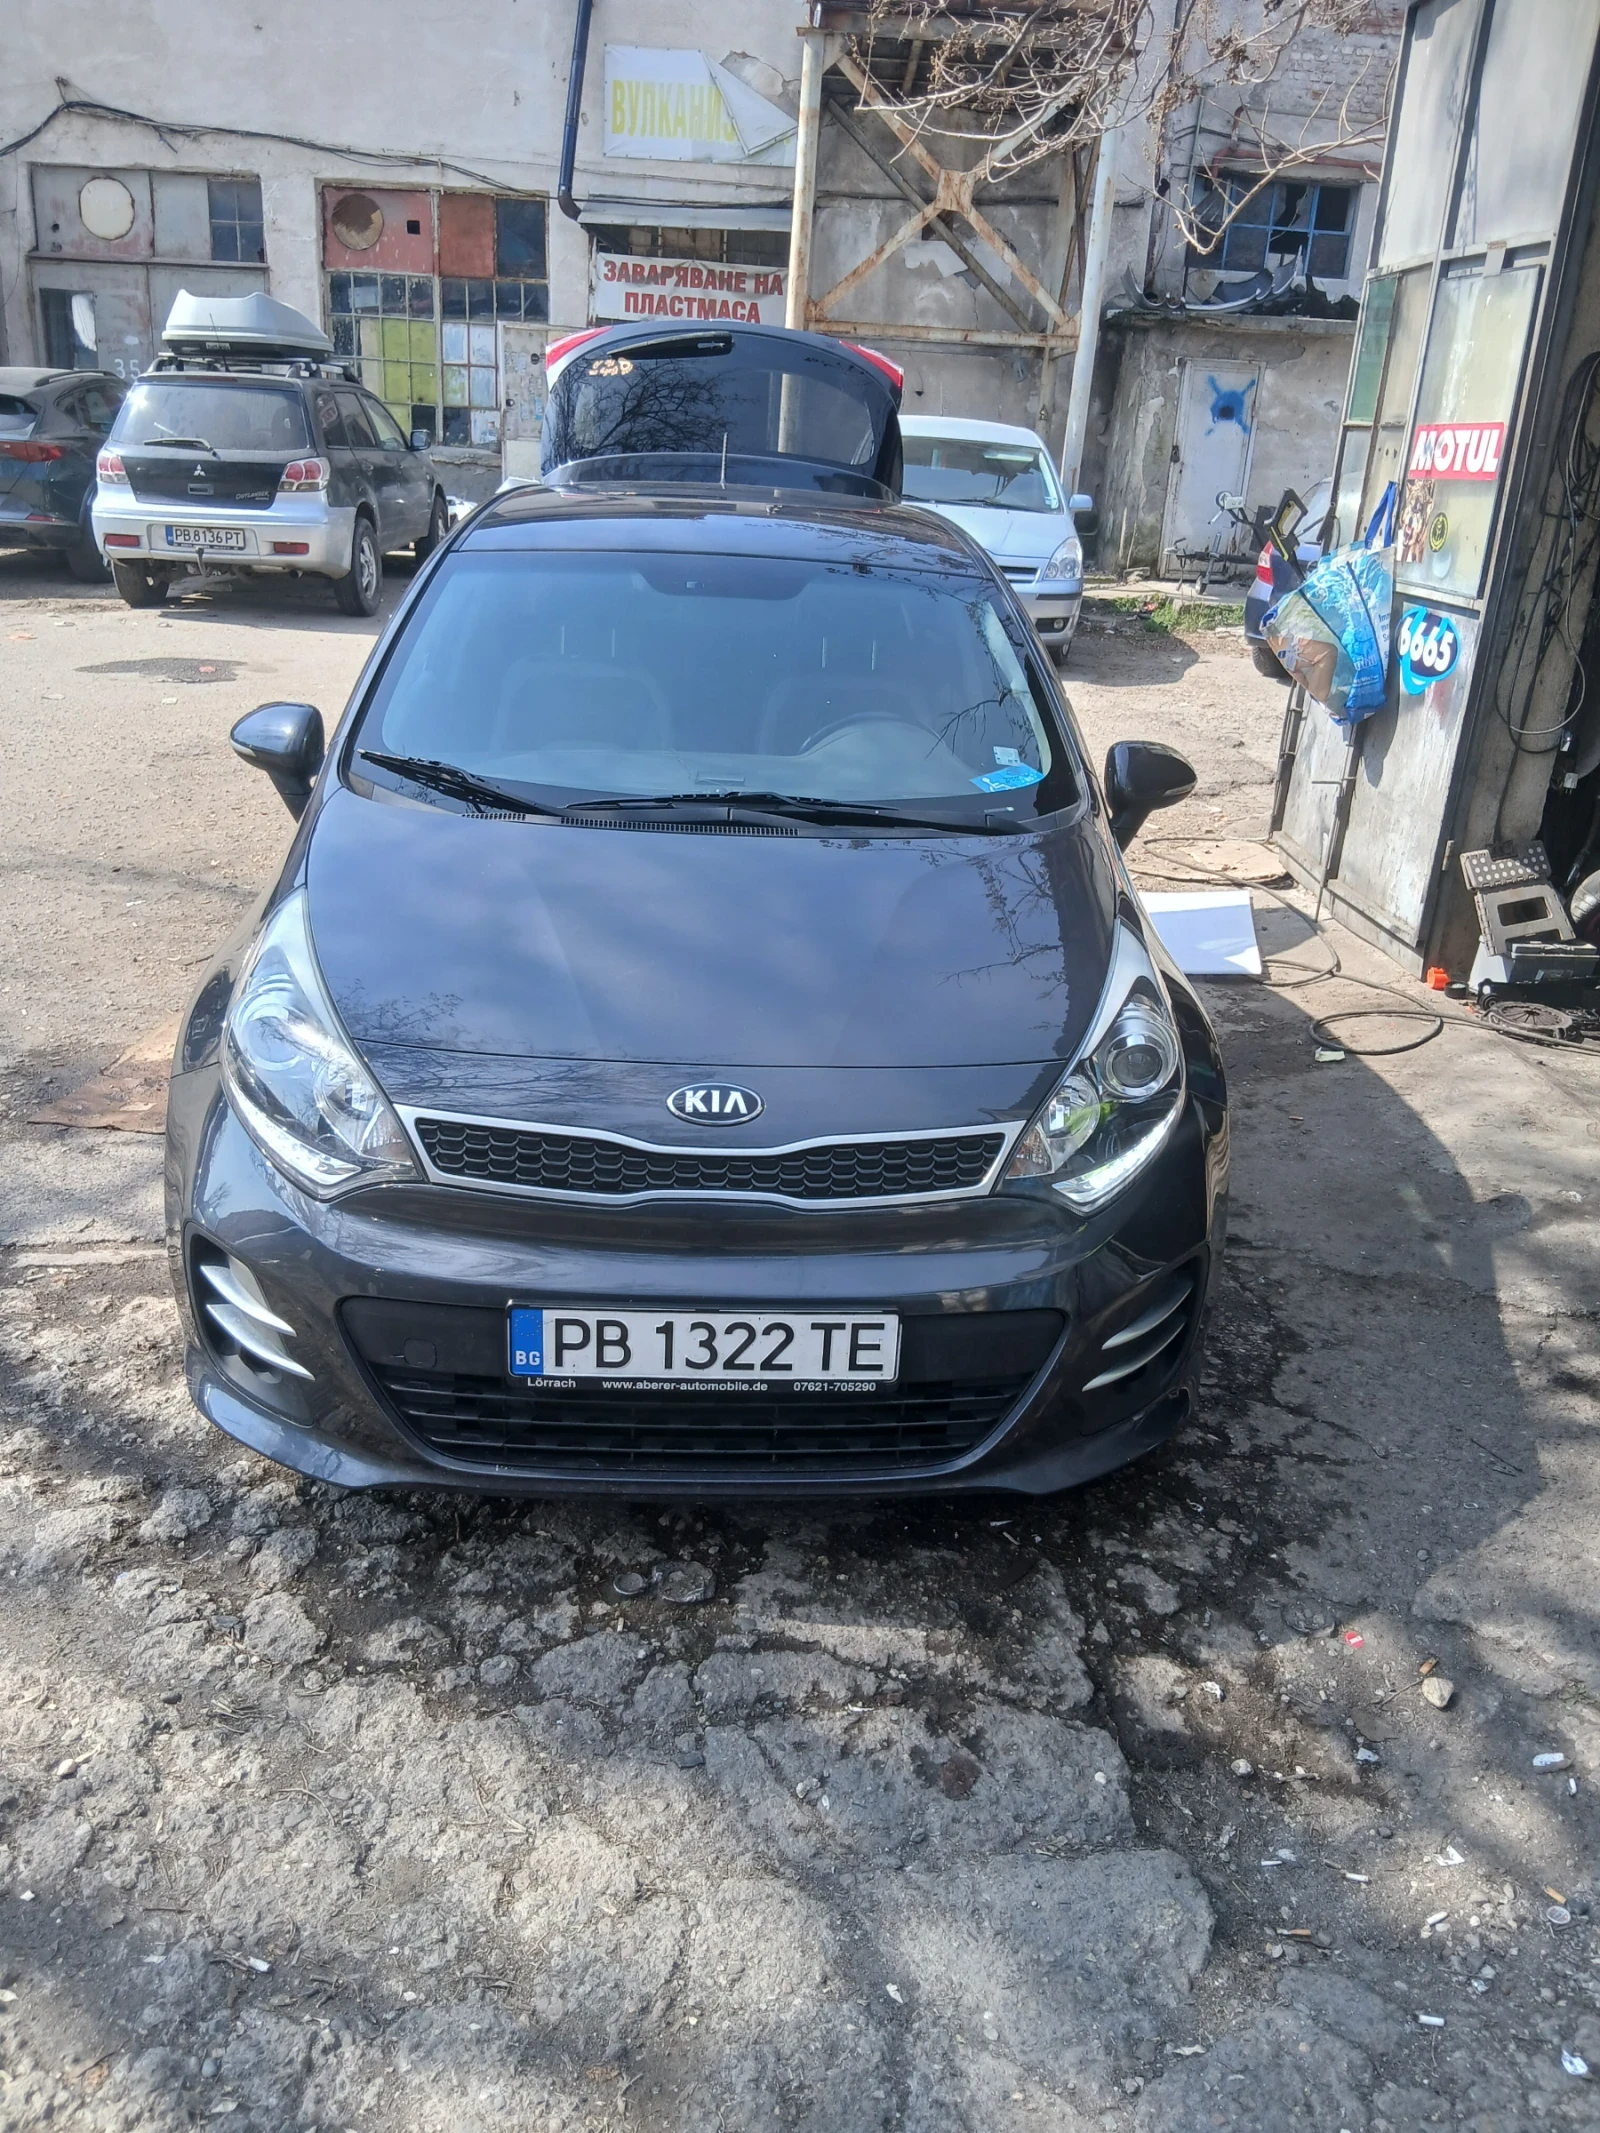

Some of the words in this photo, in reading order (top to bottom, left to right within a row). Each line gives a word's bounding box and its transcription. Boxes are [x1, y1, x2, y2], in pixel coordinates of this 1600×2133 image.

[603, 260, 747, 293] ЗАВАРЯВАНЕ
[754, 273, 784, 296] НА
[624, 291, 761, 324] ПЛАСТМАСА
[1409, 429, 1500, 473] MOTUL
[174, 528, 191, 542] PB
[193, 529, 223, 544] 8136
[225, 531, 241, 545] PT
[1398, 616, 1454, 672] 6665
[684, 1089, 748, 1114] KIA
[515, 1351, 540, 1366] BG
[554, 1318, 632, 1368] PB
[655, 1321, 795, 1371] 1322
[810, 1322, 885, 1372] TE
[527, 1376, 576, 1388] Lörrach
[602, 1380, 768, 1391] www.aberer-automobile.de
[793, 1382, 877, 1392] 07621-705290
